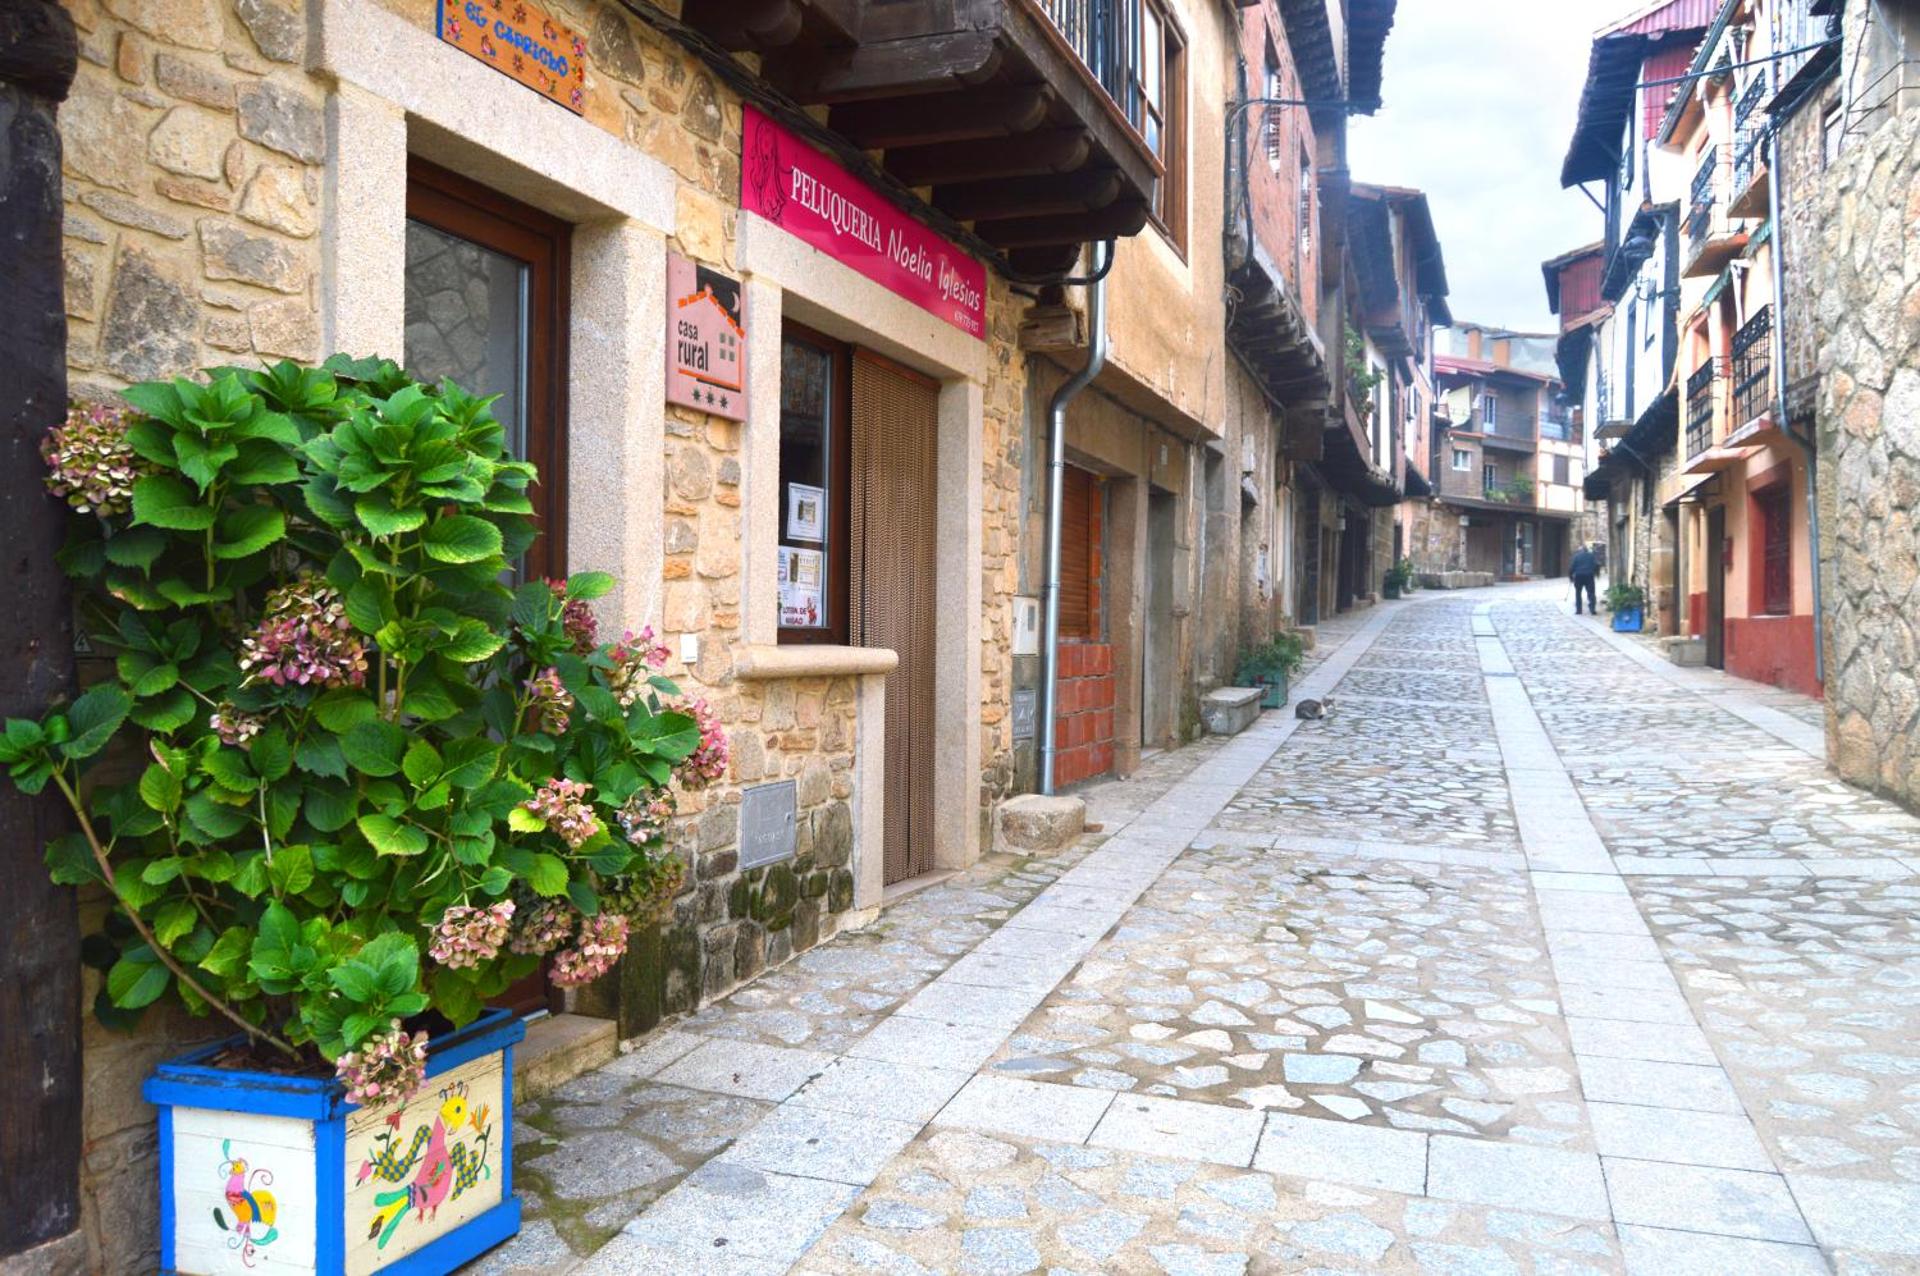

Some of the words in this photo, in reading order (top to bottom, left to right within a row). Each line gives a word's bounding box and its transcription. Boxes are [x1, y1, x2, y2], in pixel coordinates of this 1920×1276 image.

[791, 165, 882, 253] PELUQUERIA
[887, 228, 933, 283] Noelia
[938, 259, 981, 312] Iglesias
[678, 319, 698, 340] casa
[678, 338, 708, 371] rural
